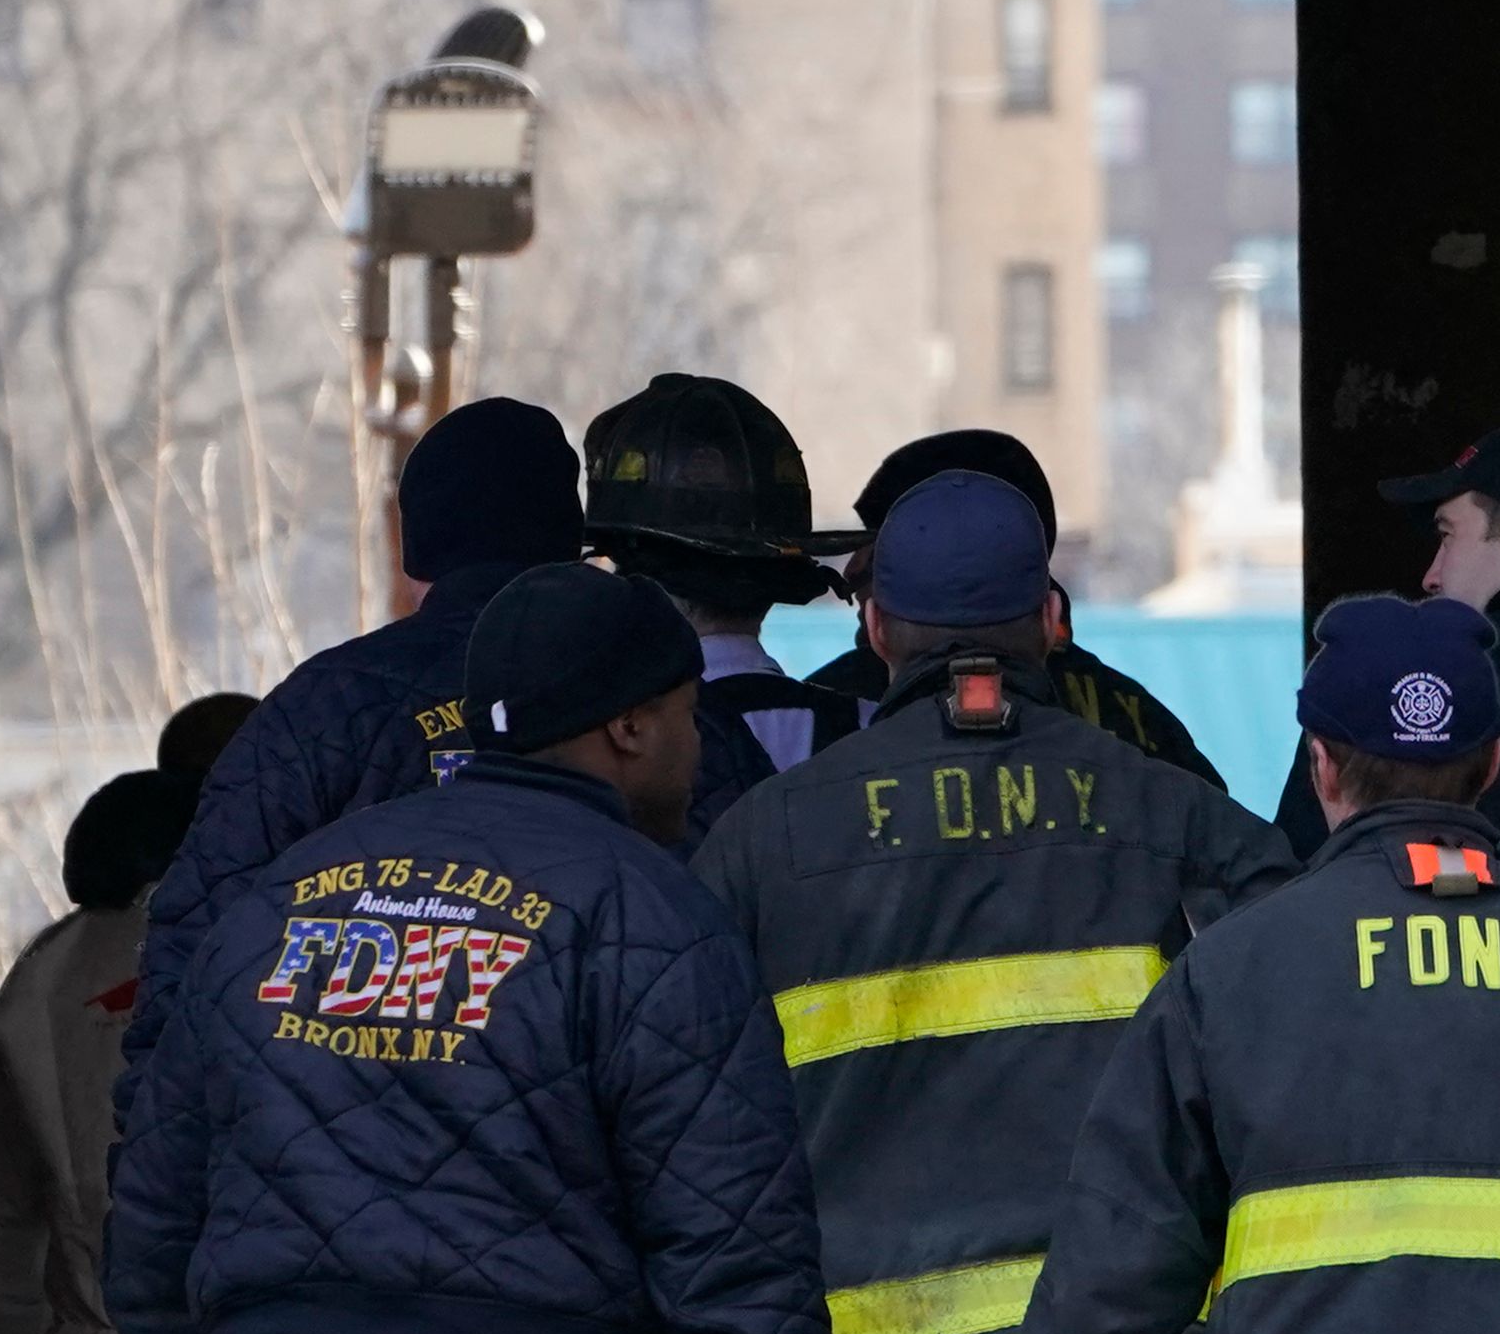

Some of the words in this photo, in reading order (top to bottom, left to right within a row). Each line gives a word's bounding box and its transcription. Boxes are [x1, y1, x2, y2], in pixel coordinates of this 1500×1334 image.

[414, 696, 467, 741] EN
[291, 861, 370, 905] ENG.
[376, 857, 415, 888] 75
[433, 862, 512, 912] LAD.
[511, 892, 552, 930] 33
[353, 890, 423, 919] Animal
[422, 896, 478, 922] House
[257, 917, 531, 1030] FDNY
